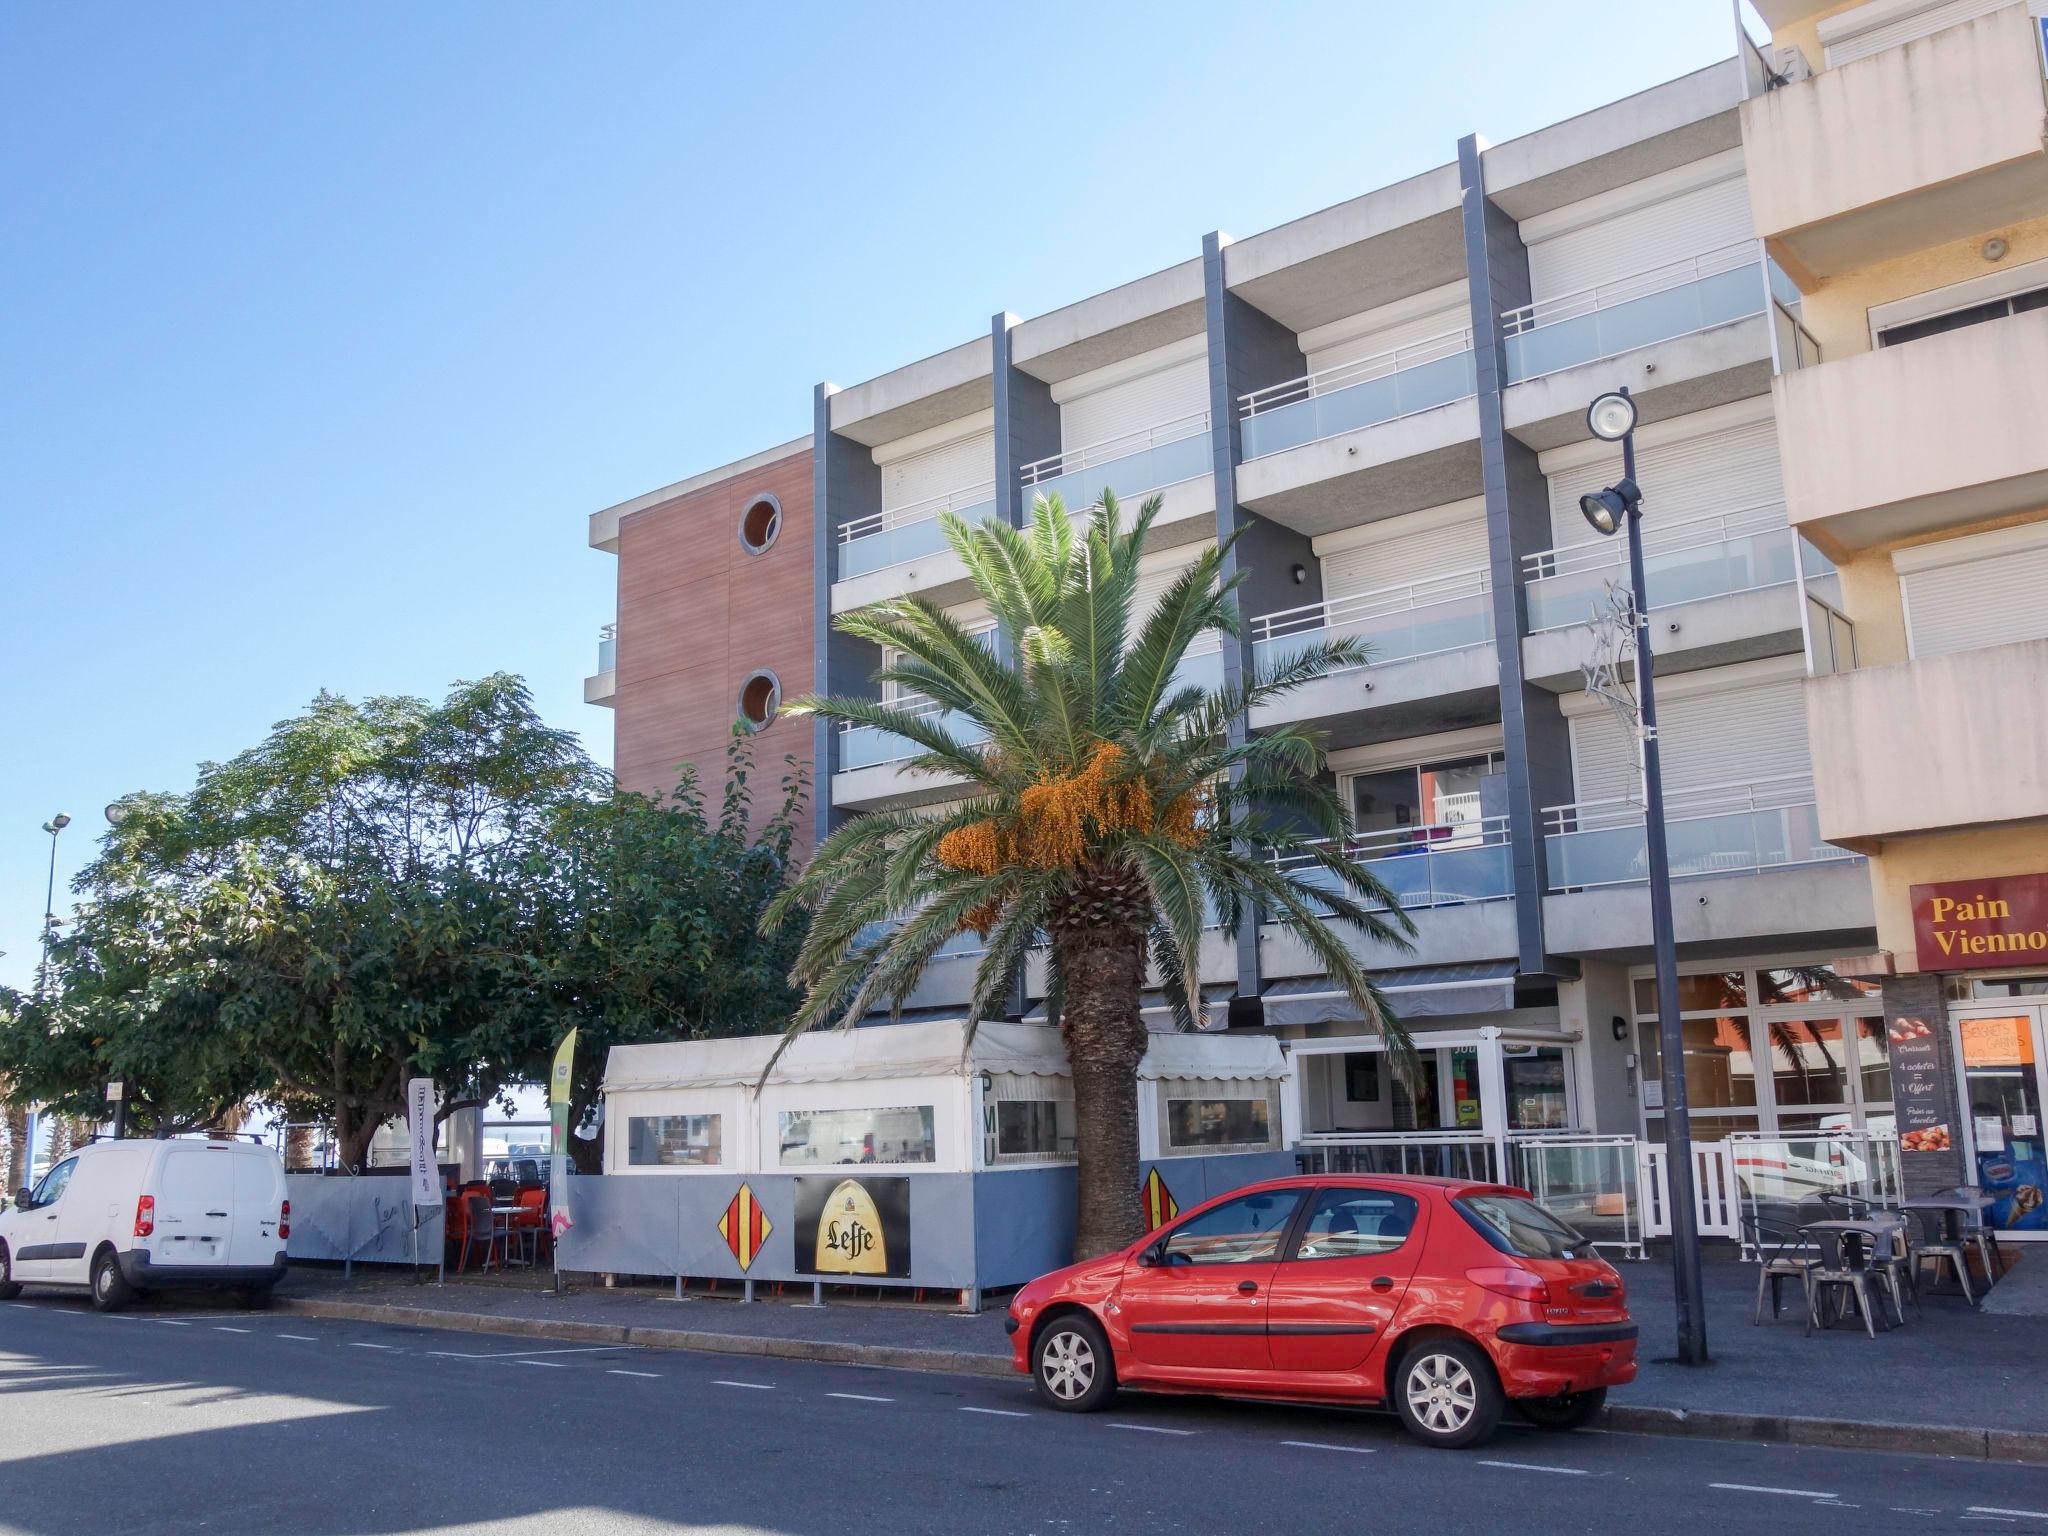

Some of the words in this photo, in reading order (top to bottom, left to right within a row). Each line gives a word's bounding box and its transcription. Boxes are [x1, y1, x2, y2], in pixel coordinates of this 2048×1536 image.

[1930, 895, 2010, 922] Pain
[1932, 924, 2048, 956] Vienno
[825, 1220, 876, 1261] Leffe
